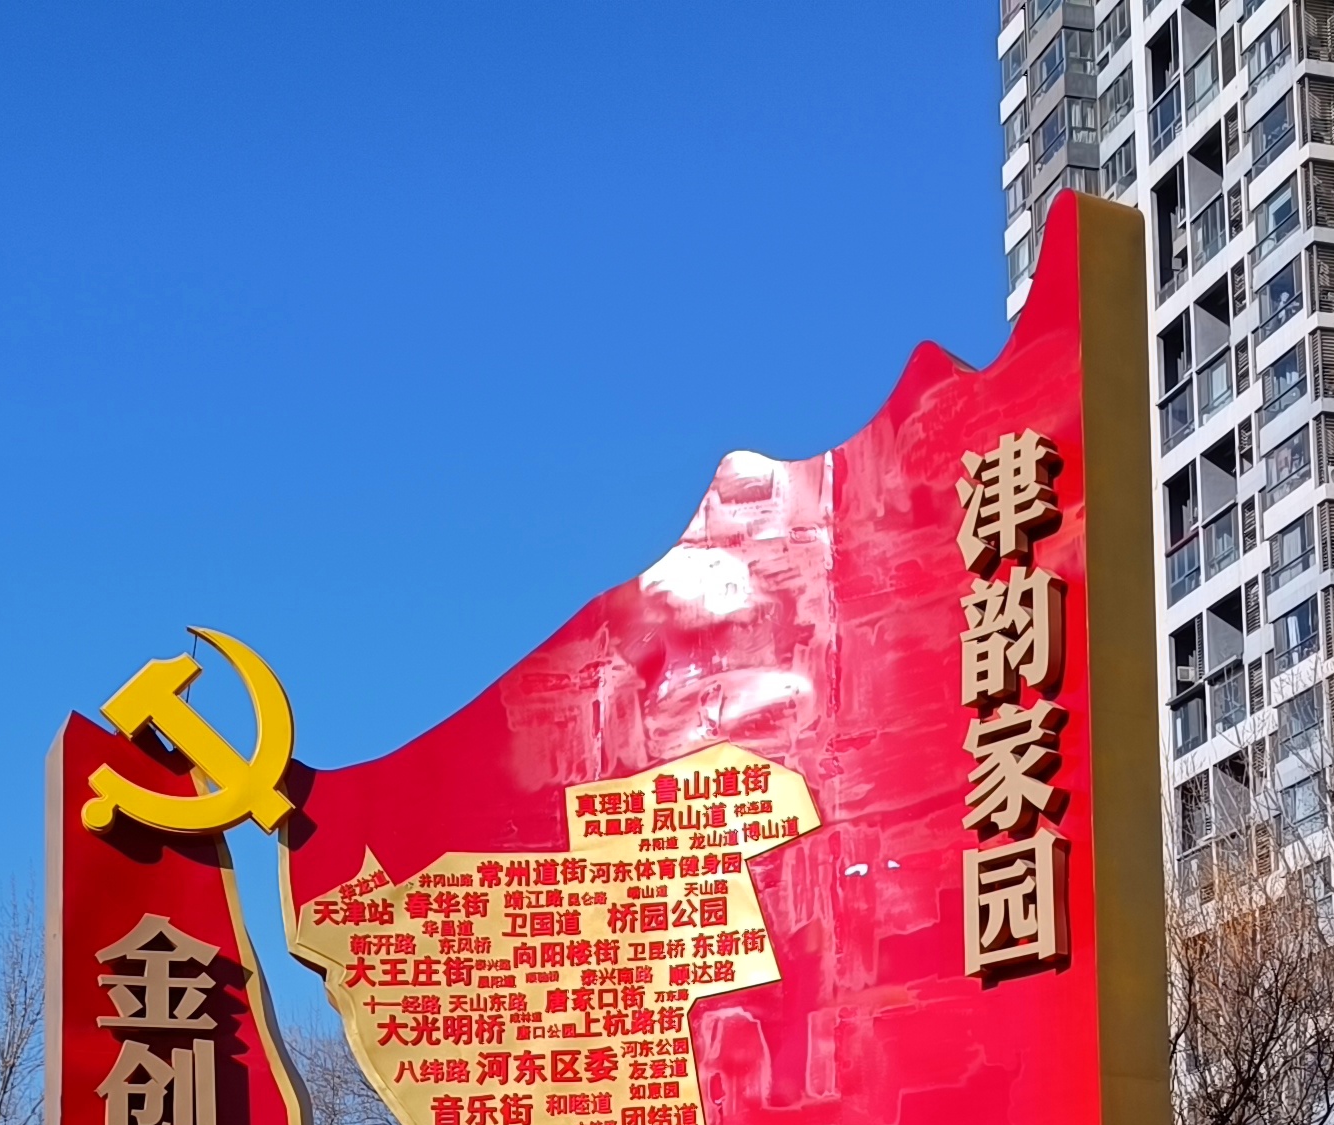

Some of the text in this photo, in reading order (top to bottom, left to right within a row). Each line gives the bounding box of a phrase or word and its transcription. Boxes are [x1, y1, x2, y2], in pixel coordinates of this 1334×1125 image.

[955, 427, 1064, 978] 津韵家园
[651, 764, 771, 804] 鲁山道街
[575, 790, 645, 817] 真理道
[651, 802, 727, 833] 凤山道
[742, 816, 800, 842] 博山道
[689, 829, 739, 850] 龙山道
[418, 873, 473, 888] 井冈山路
[476, 858, 587, 888] 常州道街
[589, 852, 742, 884] 河东体育健身园
[339, 869, 390, 901] 华龙道
[684, 879, 729, 897] 天山路
[313, 898, 394, 926] 天津站
[404, 890, 489, 920] 春华街
[503, 889, 563, 910] 靖江路
[502, 909, 581, 938] 卫国道
[607, 896, 728, 933] 桥园公园
[421, 919, 475, 937] 华昌道
[350, 933, 417, 955] 新开路
[438, 936, 491, 955] 东风桥
[513, 939, 620, 968] 向阳楼街
[627, 939, 685, 962] 卫昆桥
[691, 928, 766, 959] 东新街
[345, 956, 475, 988] 大王庄街
[581, 965, 653, 987] 泰兴南路
[668, 960, 735, 985] 顺达路
[363, 994, 442, 1015] 十一经路
[448, 993, 528, 1013] 天山东路
[545, 985, 646, 1014] 唐家口街
[377, 1014, 506, 1046] 大光明桥
[576, 1006, 684, 1038] 上杭路街
[621, 1037, 689, 1058] 河东公园
[394, 1058, 470, 1084] 八纬路
[476, 1046, 619, 1086] 河东区委
[628, 1057, 689, 1080] 友爱道
[546, 1091, 612, 1116] 和睦道
[629, 1081, 680, 1100] 如意园
